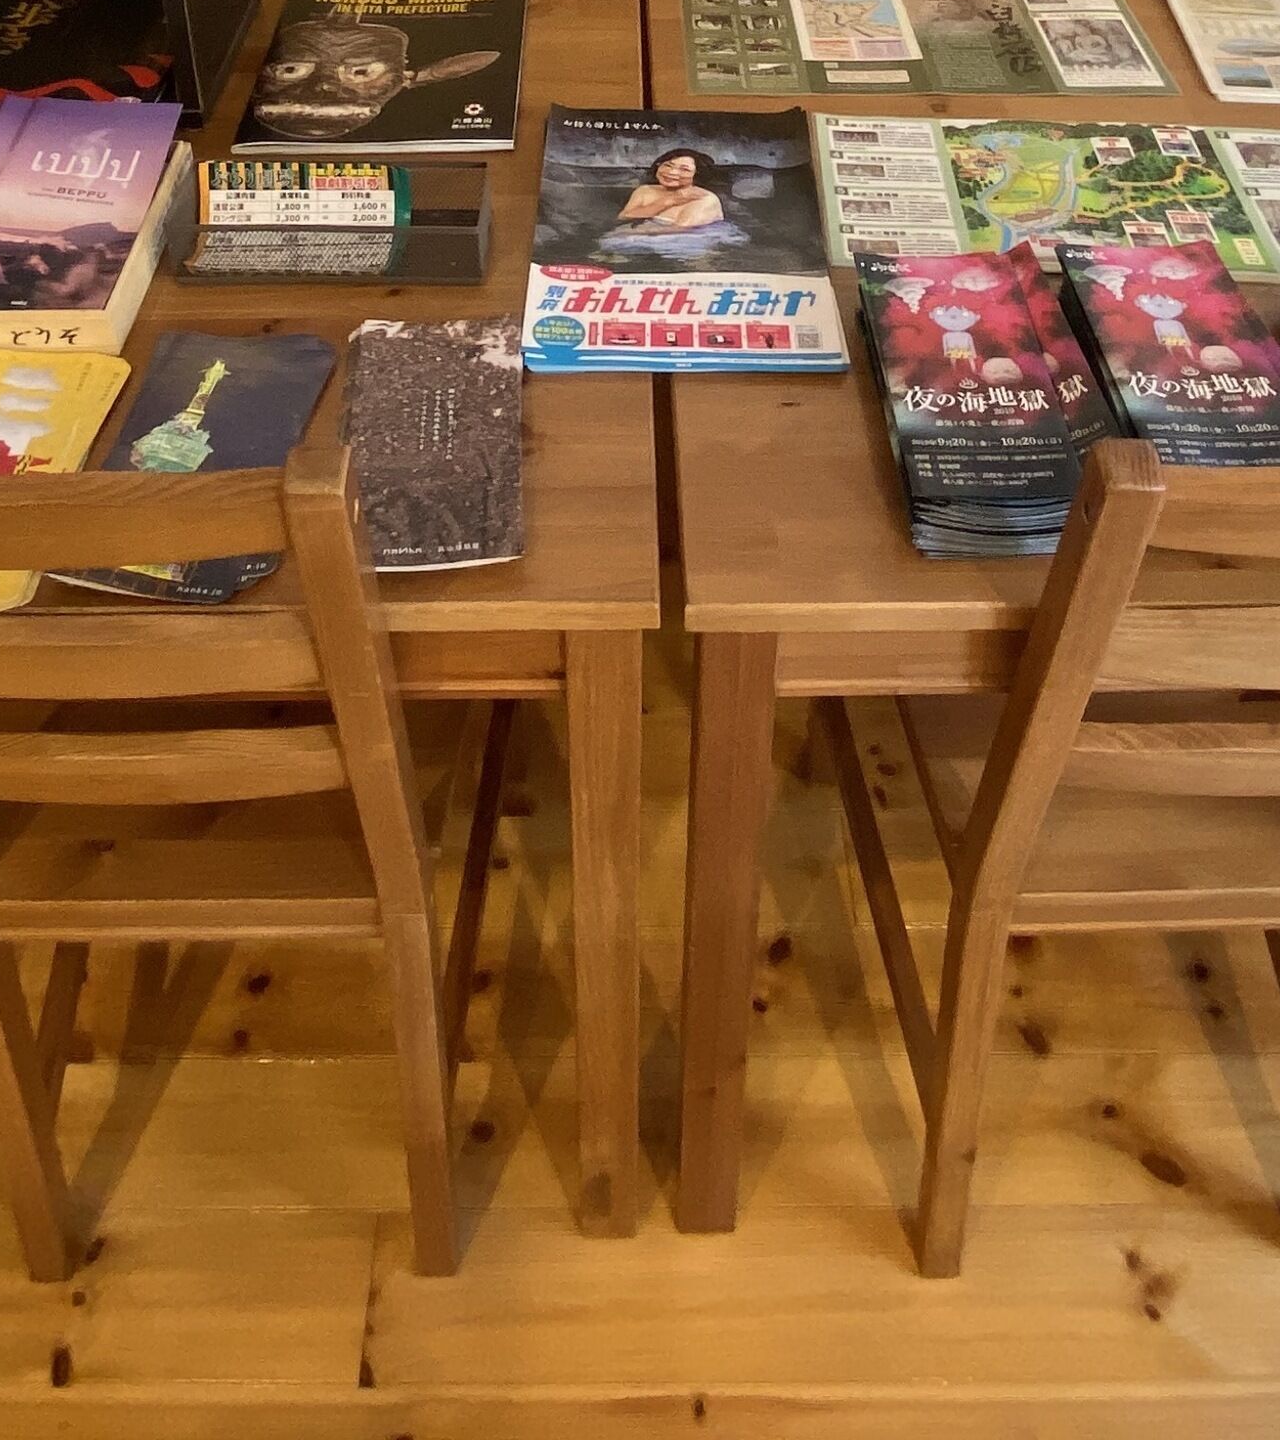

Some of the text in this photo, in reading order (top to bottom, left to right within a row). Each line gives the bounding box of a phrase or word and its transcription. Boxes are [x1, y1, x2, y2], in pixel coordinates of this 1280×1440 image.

[386, 3, 468, 15] PREFECTURE
[57, 187, 107, 199] BEPPU
[12, 326, 81, 346] どうぞ
[1128, 370, 1276, 401] 夜の海地獄
[903, 383, 1051, 415] 夜の海地獄
